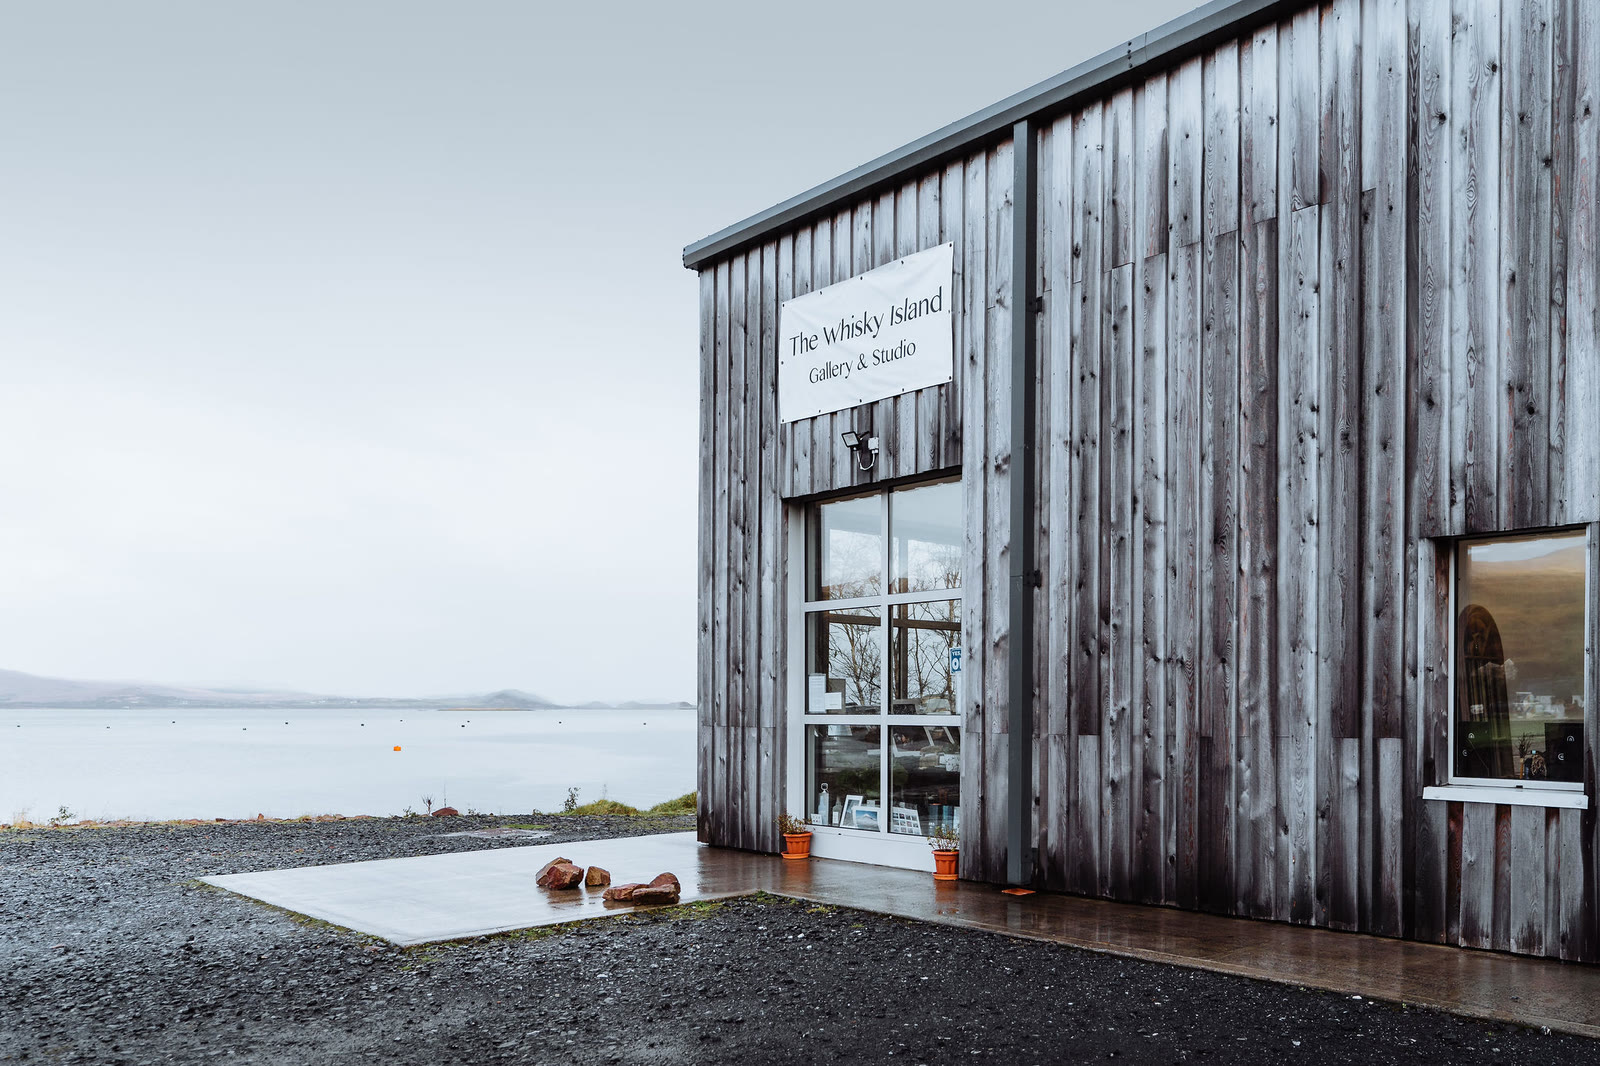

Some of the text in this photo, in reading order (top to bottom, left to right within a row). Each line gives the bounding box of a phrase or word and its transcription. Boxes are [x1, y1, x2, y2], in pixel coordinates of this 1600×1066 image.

[789, 286, 943, 356] The Whisky Island
[809, 339, 916, 384] Gallery & Studio
